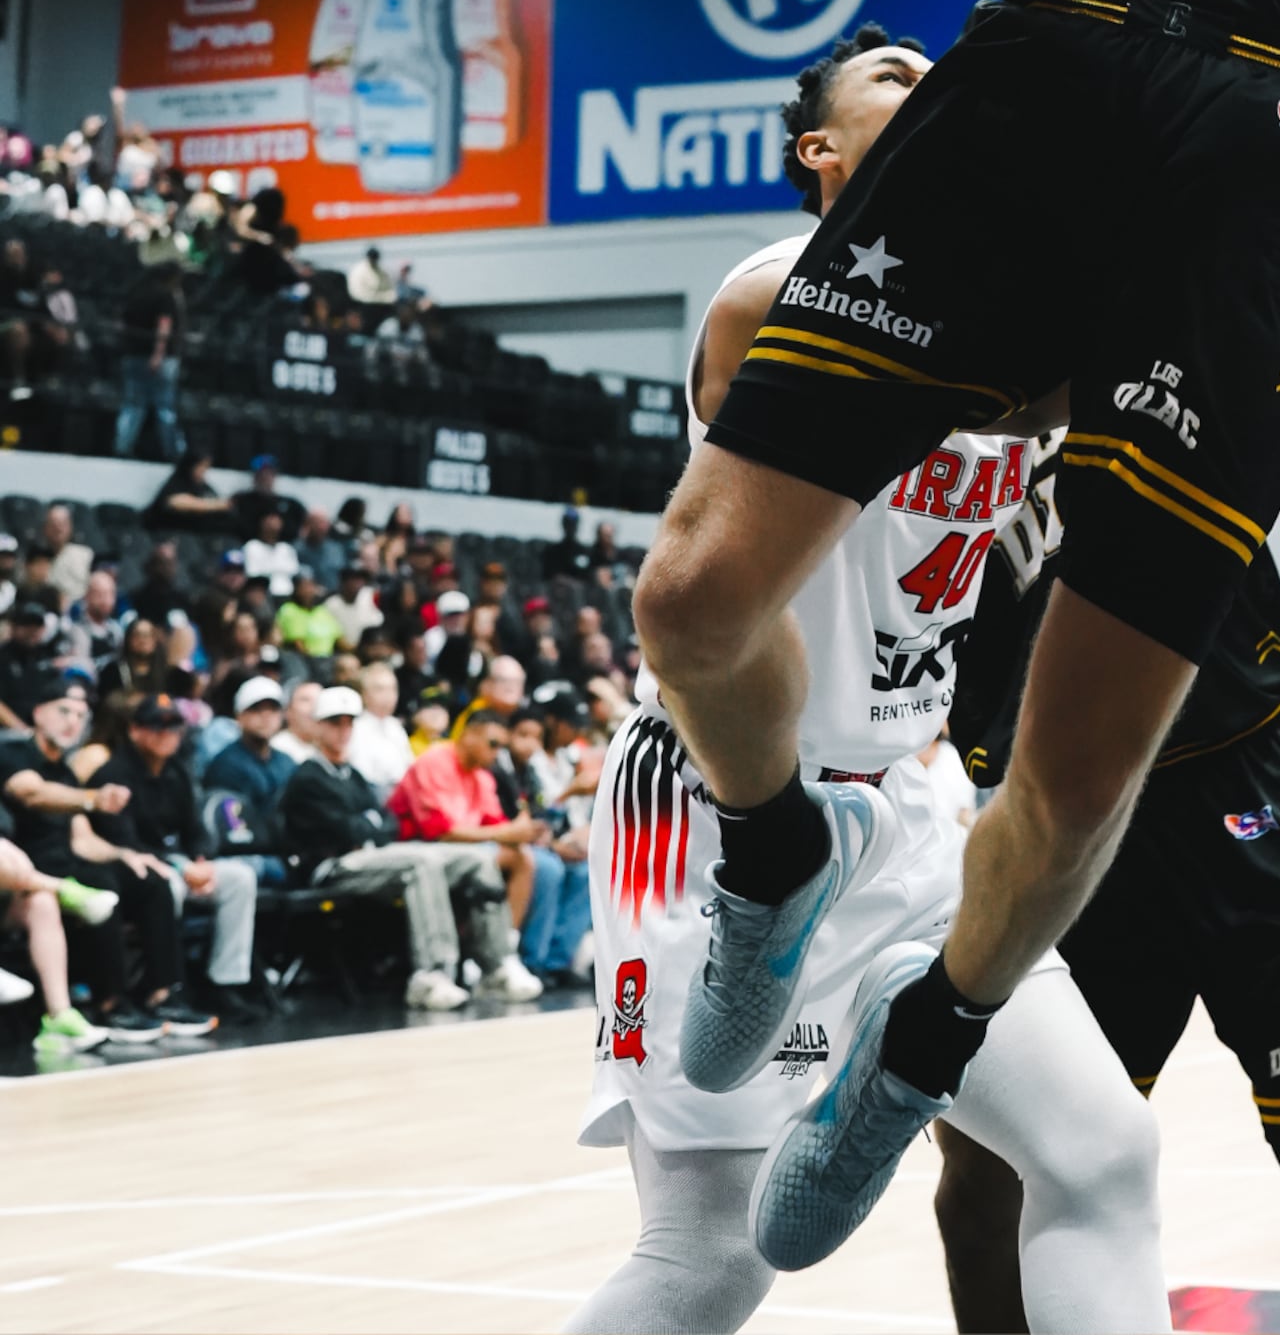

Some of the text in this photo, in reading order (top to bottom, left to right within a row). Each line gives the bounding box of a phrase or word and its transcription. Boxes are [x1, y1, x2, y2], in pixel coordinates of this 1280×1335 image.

[780, 275, 933, 348] Heineken
[1150, 359, 1184, 389] LOS
[897, 528, 996, 614] 40
